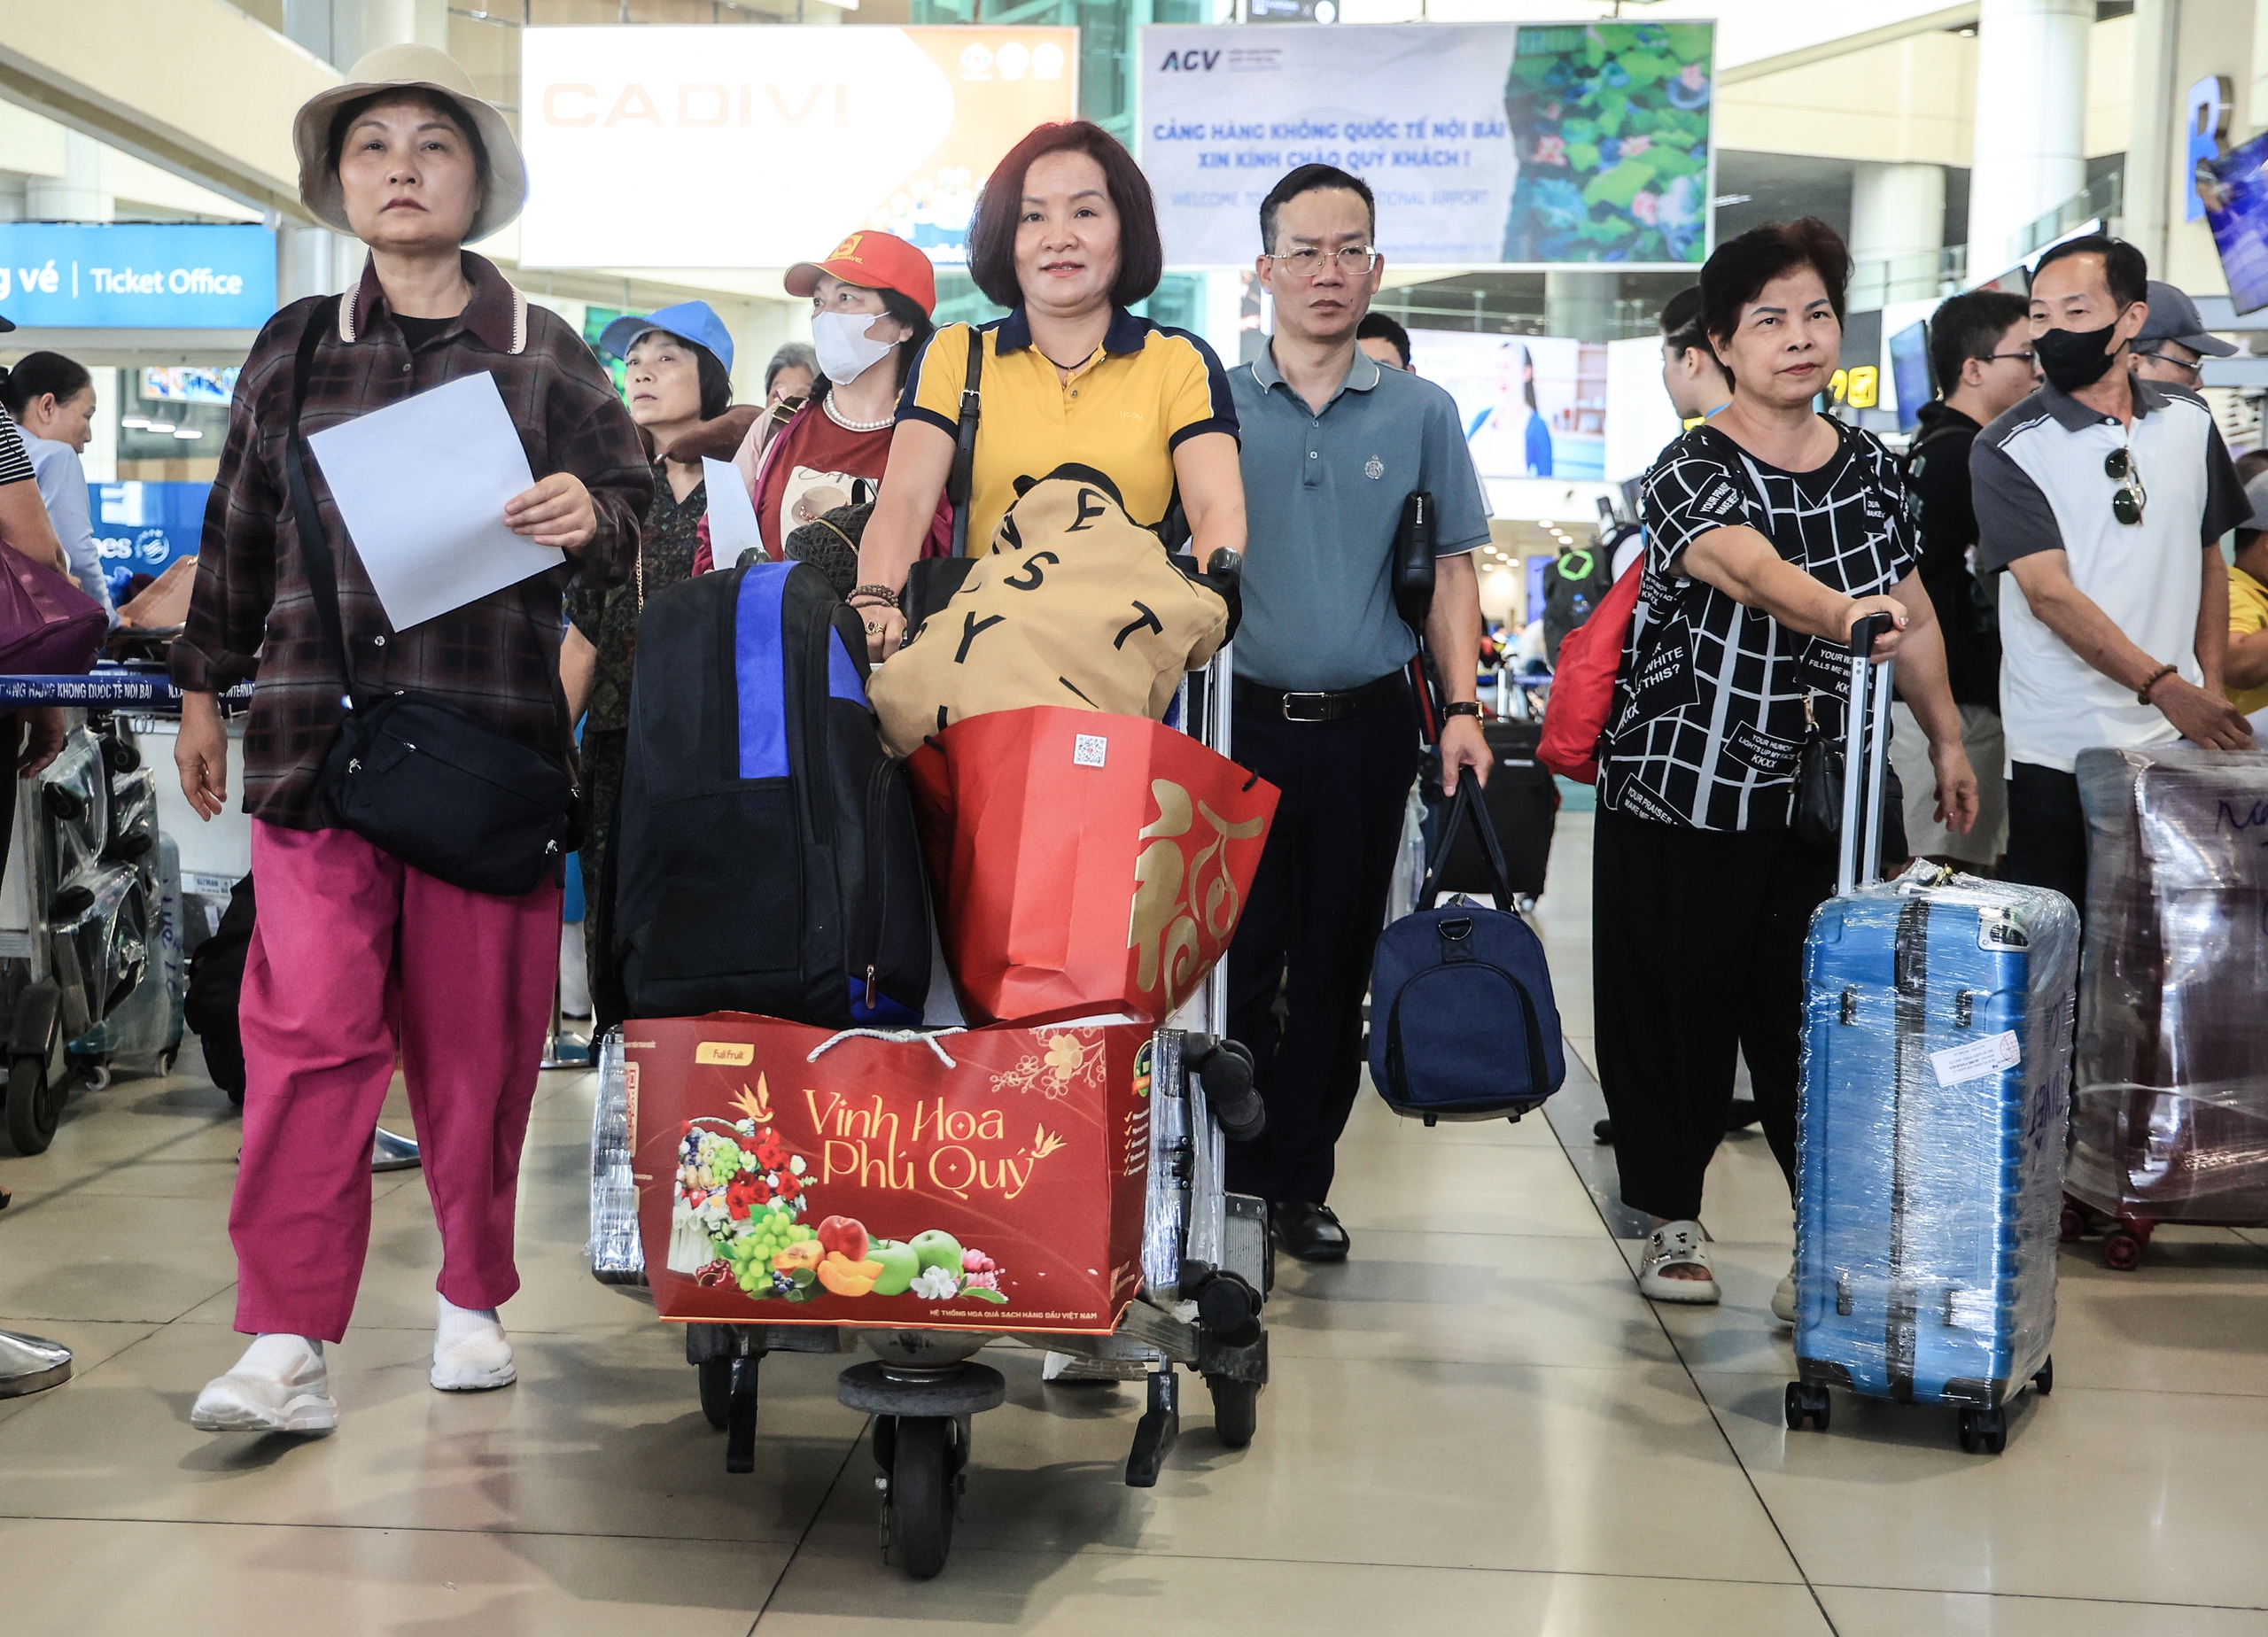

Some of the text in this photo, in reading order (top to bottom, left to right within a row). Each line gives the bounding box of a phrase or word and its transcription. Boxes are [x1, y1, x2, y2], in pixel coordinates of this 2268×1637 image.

[1161, 50, 1220, 71] ACV
[543, 83, 848, 128] CADIVI
[1210, 120, 1264, 140] HÀNG
[1270, 118, 1339, 140] KHÔNG
[1345, 116, 1397, 142] QUỐC
[1405, 116, 1429, 139] TẾ
[1198, 151, 1229, 167] XIN
[1235, 148, 1280, 167] KÍNH
[1391, 147, 1459, 167] KHÁCH
[1170, 190, 1239, 207] WELCOME
[18, 259, 59, 293] vé
[89, 267, 165, 294] Ticket
[168, 268, 244, 295] Office
[954, 610, 1007, 664] Y
[1113, 600, 1164, 651] T
[1808, 658, 1830, 671] FILLS
[1820, 648, 1843, 663] YOUR
[1752, 733, 1768, 747] YOUR
[1642, 797, 1673, 825] PRAISES
[803, 1089, 1004, 1142] Vinh Hoa
[824, 1138, 1035, 1200] Phú Quý
[941, 1308, 967, 1317] THỐNG
[1022, 1310, 1045, 1319] HÀNG
[1062, 1311, 1079, 1320] VIỆT
